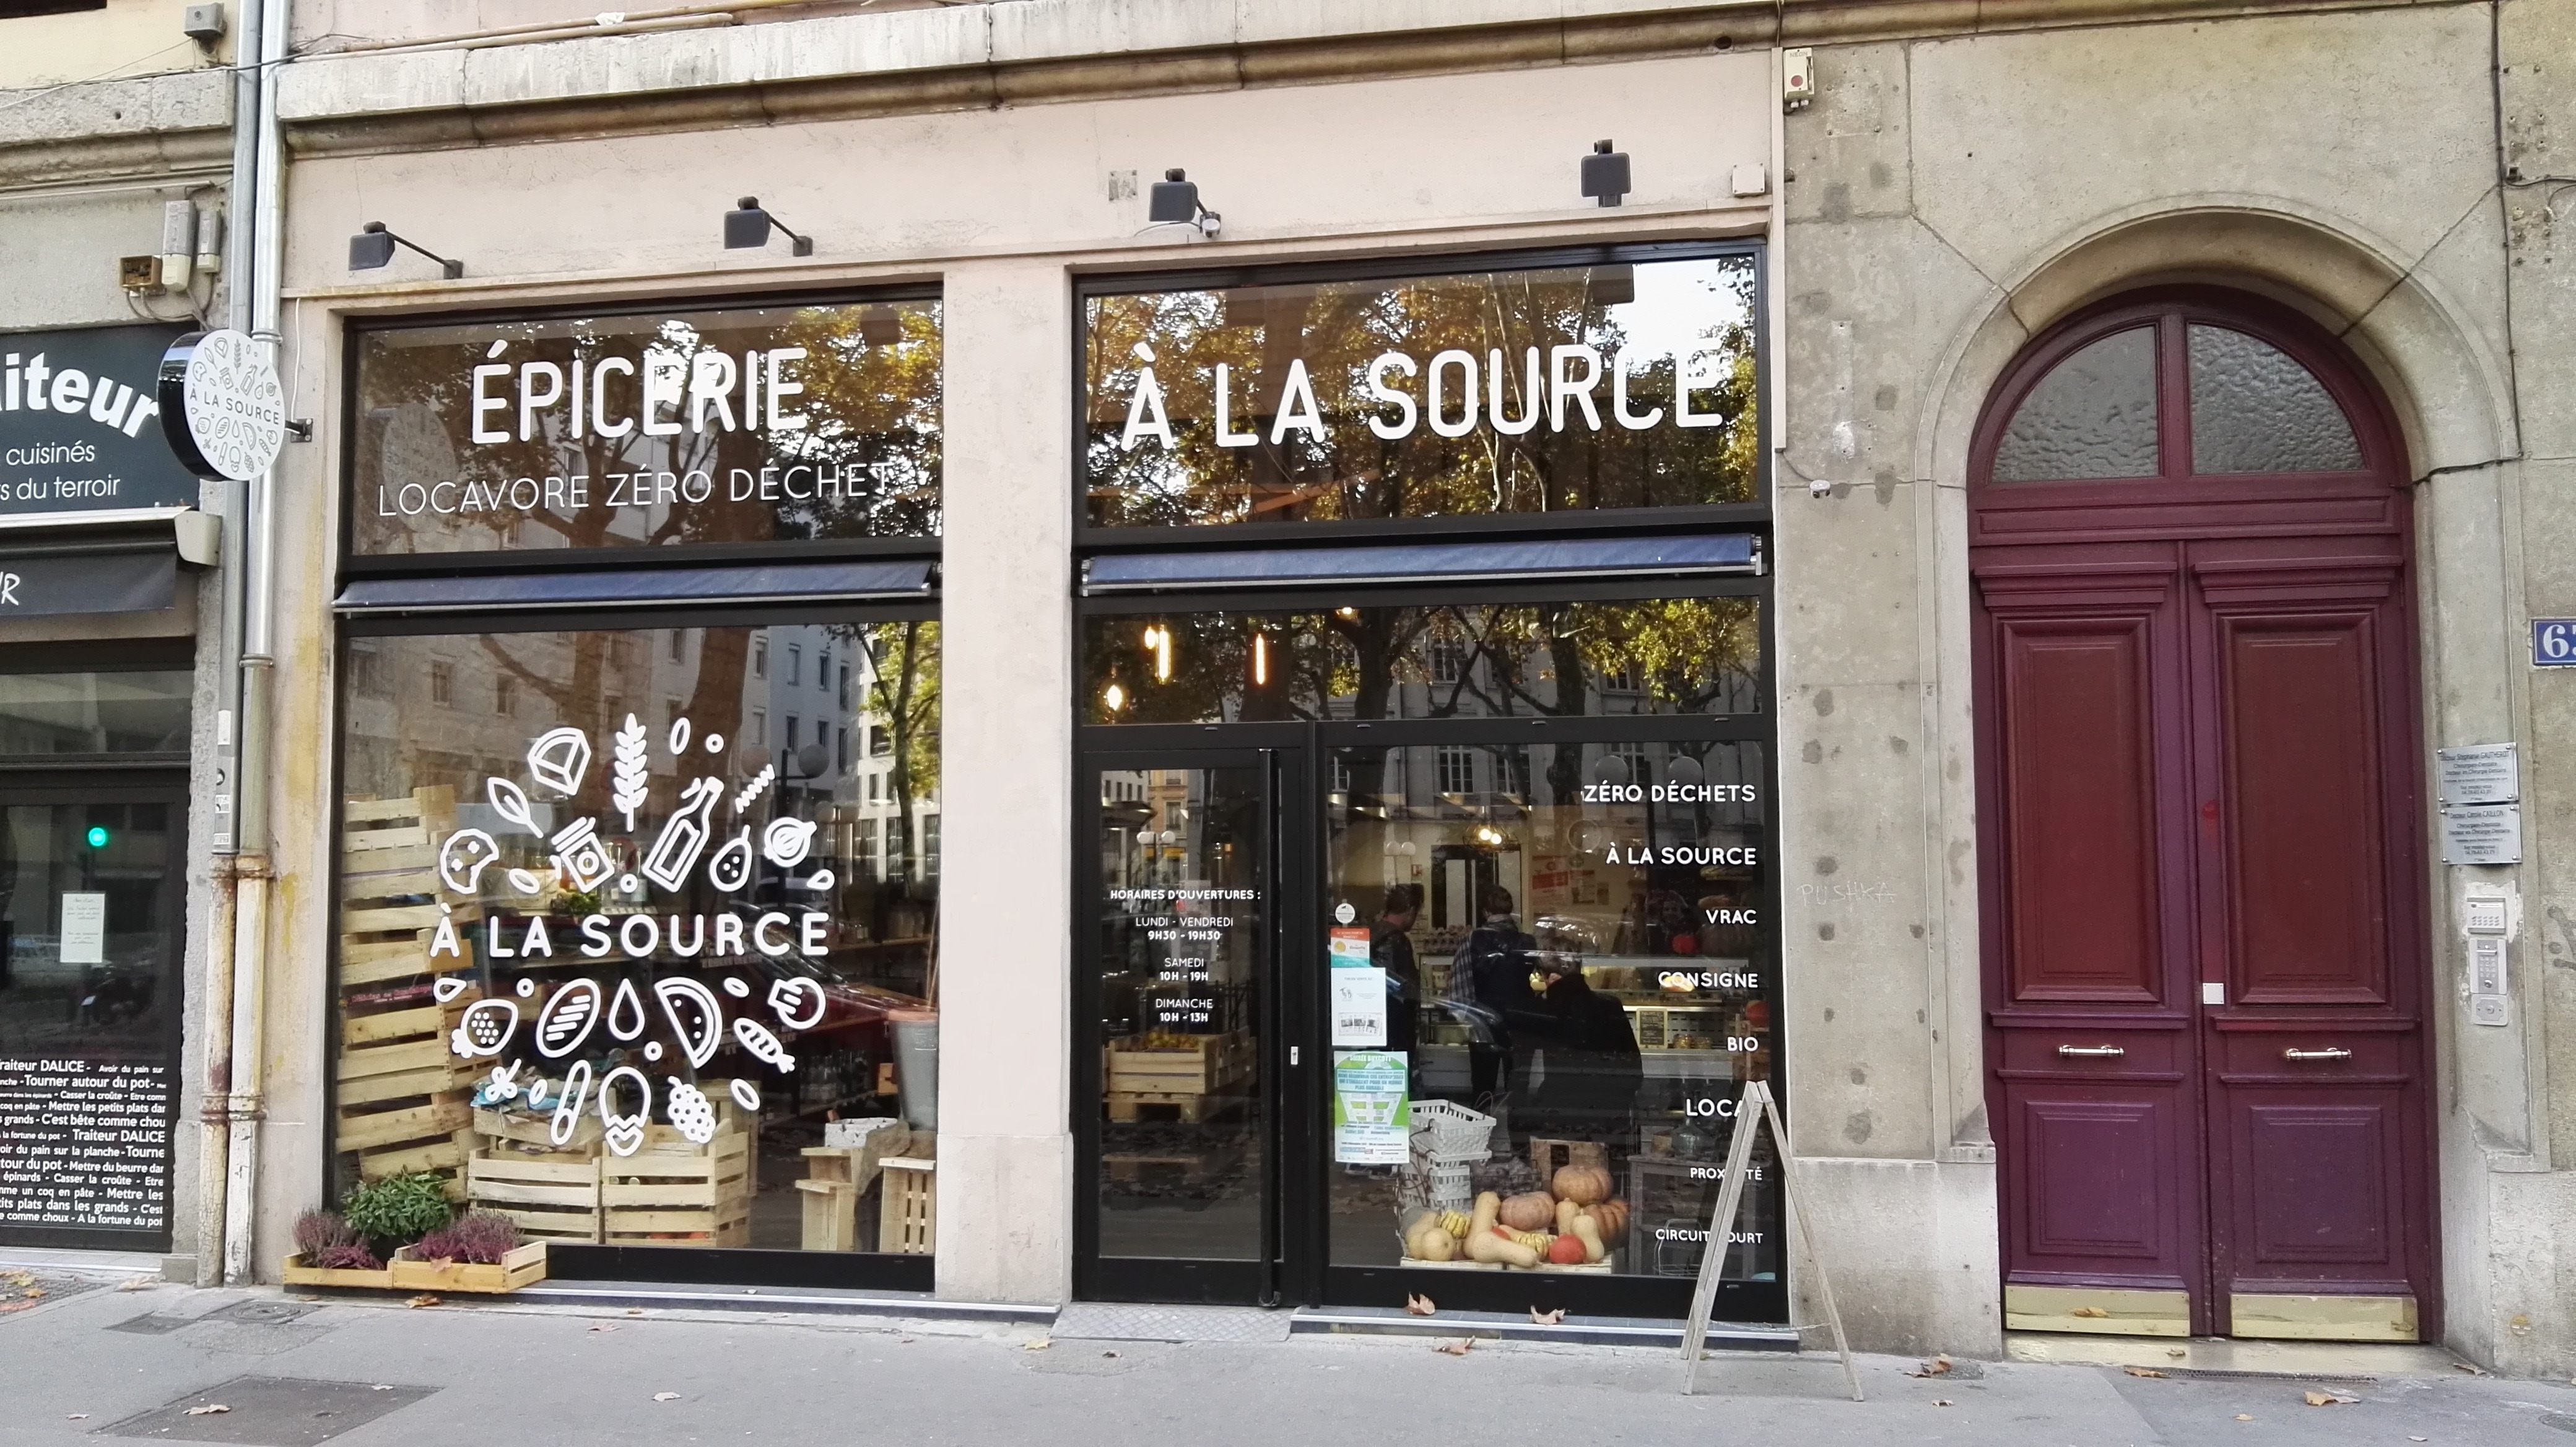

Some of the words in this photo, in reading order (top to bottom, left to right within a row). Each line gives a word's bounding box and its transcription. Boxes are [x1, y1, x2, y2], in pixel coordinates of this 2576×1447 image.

[0, 351, 159, 438] iteur
[471, 339, 807, 445] ÉPICERIE
[1121, 342, 1174, 451] À
[1216, 357, 1326, 448] LA
[1367, 338, 1723, 441] SOURCE
[189, 383, 198, 401] À
[204, 391, 219, 408] LA
[225, 398, 279, 425] SOURCE
[6, 440, 95, 465] cuisinés
[0, 483, 10, 501] s
[16, 478, 47, 500] du
[53, 473, 121, 498] terroir
[378, 475, 589, 517] LOCAVORE
[605, 464, 712, 507] ZÉRO
[731, 458, 896, 502] DÉCHET
[2543, 624, 2576, 658] 6
[1583, 779, 1643, 802] ZÉRO
[1651, 779, 1756, 802] DÉCHETS
[1606, 842, 1620, 864] À
[1628, 847, 1654, 864] LA
[1661, 847, 1757, 865] SOURCE
[1110, 890, 1165, 899] HORAIRES
[1168, 890, 1254, 899] D'OUVERTURES
[1796, 880, 1897, 909] PUSHKA
[1135, 917, 1168, 927] LUNDI
[1180, 917, 1234, 927] VENDREDI
[1705, 909, 1757, 924] VRAC
[429, 903, 460, 958] À
[489, 915, 553, 958] LA
[580, 912, 829, 958] SOURCE
[1147, 930, 1177, 940] 9H30
[1188, 930, 1221, 940] 19H30
[1164, 958, 1204, 968] SAMEDI
[1160, 972, 1179, 981] 10H
[1190, 972, 1208, 981] 19H
[1658, 971, 1758, 988] CONSIGNE
[1155, 999, 1214, 1008] DIMANCHE
[1160, 1012, 1179, 1021] 10H
[1190, 1012, 1208, 1021] 13H
[1727, 1036, 1758, 1052] BIO
[0, 1059, 37, 1072] raiteur
[40, 1059, 85, 1073] DALICE
[98, 1065, 118, 1073] Avoir
[121, 1065, 131, 1073] du
[133, 1065, 149, 1075] pain
[24, 1074, 69, 1087] Tourner
[72, 1077, 110, 1088] autour
[112, 1075, 128, 1088] du
[130, 1077, 150, 1091] pot
[60, 1090, 87, 1099] Casser
[88, 1090, 95, 1100] la
[97, 1091, 123, 1101] croûte
[0, 1103, 12, 1111] coq
[24, 1102, 41, 1112] pâte
[48, 1101, 80, 1111] Mettre
[82, 1101, 97, 1112] les
[98, 1102, 124, 1114] petits
[126, 1103, 149, 1115] plats
[1686, 1098, 1761, 1117] LOCA
[4, 1114, 35, 1127] grands
[41, 1113, 69, 1125] C'est
[70, 1113, 96, 1126] bête
[97, 1117, 137, 1127] comme
[139, 1116, 166, 1127] chou
[2, 1130, 9, 1139] la
[11, 1130, 37, 1139] fortune
[37, 1132, 47, 1140] du
[48, 1133, 61, 1142] pot
[72, 1129, 118, 1141] Traiteur
[120, 1130, 165, 1143] DALICE
[16, 1144, 28, 1155] du
[31, 1145, 50, 1157] pain
[53, 1147, 69, 1155] sur
[72, 1145, 80, 1156] la
[83, 1146, 120, 1158] planche
[125, 1145, 165, 1158] Tourne
[0, 1158, 25, 1169] tour
[26, 1157, 41, 1170] du
[42, 1159, 63, 1173] pot
[69, 1160, 101, 1171] Mettre
[102, 1161, 115, 1172] du
[116, 1162, 148, 1173] beurre
[3, 1171, 41, 1183] épinards
[53, 1173, 85, 1184] Casser
[89, 1174, 97, 1184] la
[102, 1174, 132, 1186] croûte
[144, 1176, 164, 1187] Etre
[1690, 1166, 1762, 1181] PROXTÉ
[22, 1187, 33, 1196] un
[37, 1188, 54, 1199] coq
[58, 1189, 71, 1197] en
[74, 1187, 95, 1199] pâte
[107, 1187, 144, 1200] Mettre
[148, 1188, 163, 1200] les
[17, 1197, 43, 1212] plats
[46, 1198, 71, 1211] dans
[74, 1199, 90, 1212] les
[94, 1201, 129, 1215] grands
[141, 1204, 163, 1215] C'est
[7, 1213, 40, 1222] comme
[41, 1212, 69, 1222] choux
[77, 1213, 86, 1223] A
[87, 1213, 96, 1223] la
[98, 1214, 132, 1225] fortune
[133, 1215, 146, 1226] du
[147, 1217, 163, 1228] pot
[1655, 1228, 1710, 1241] CIRCUIT
[1728, 1231, 1763, 1244] OURT
